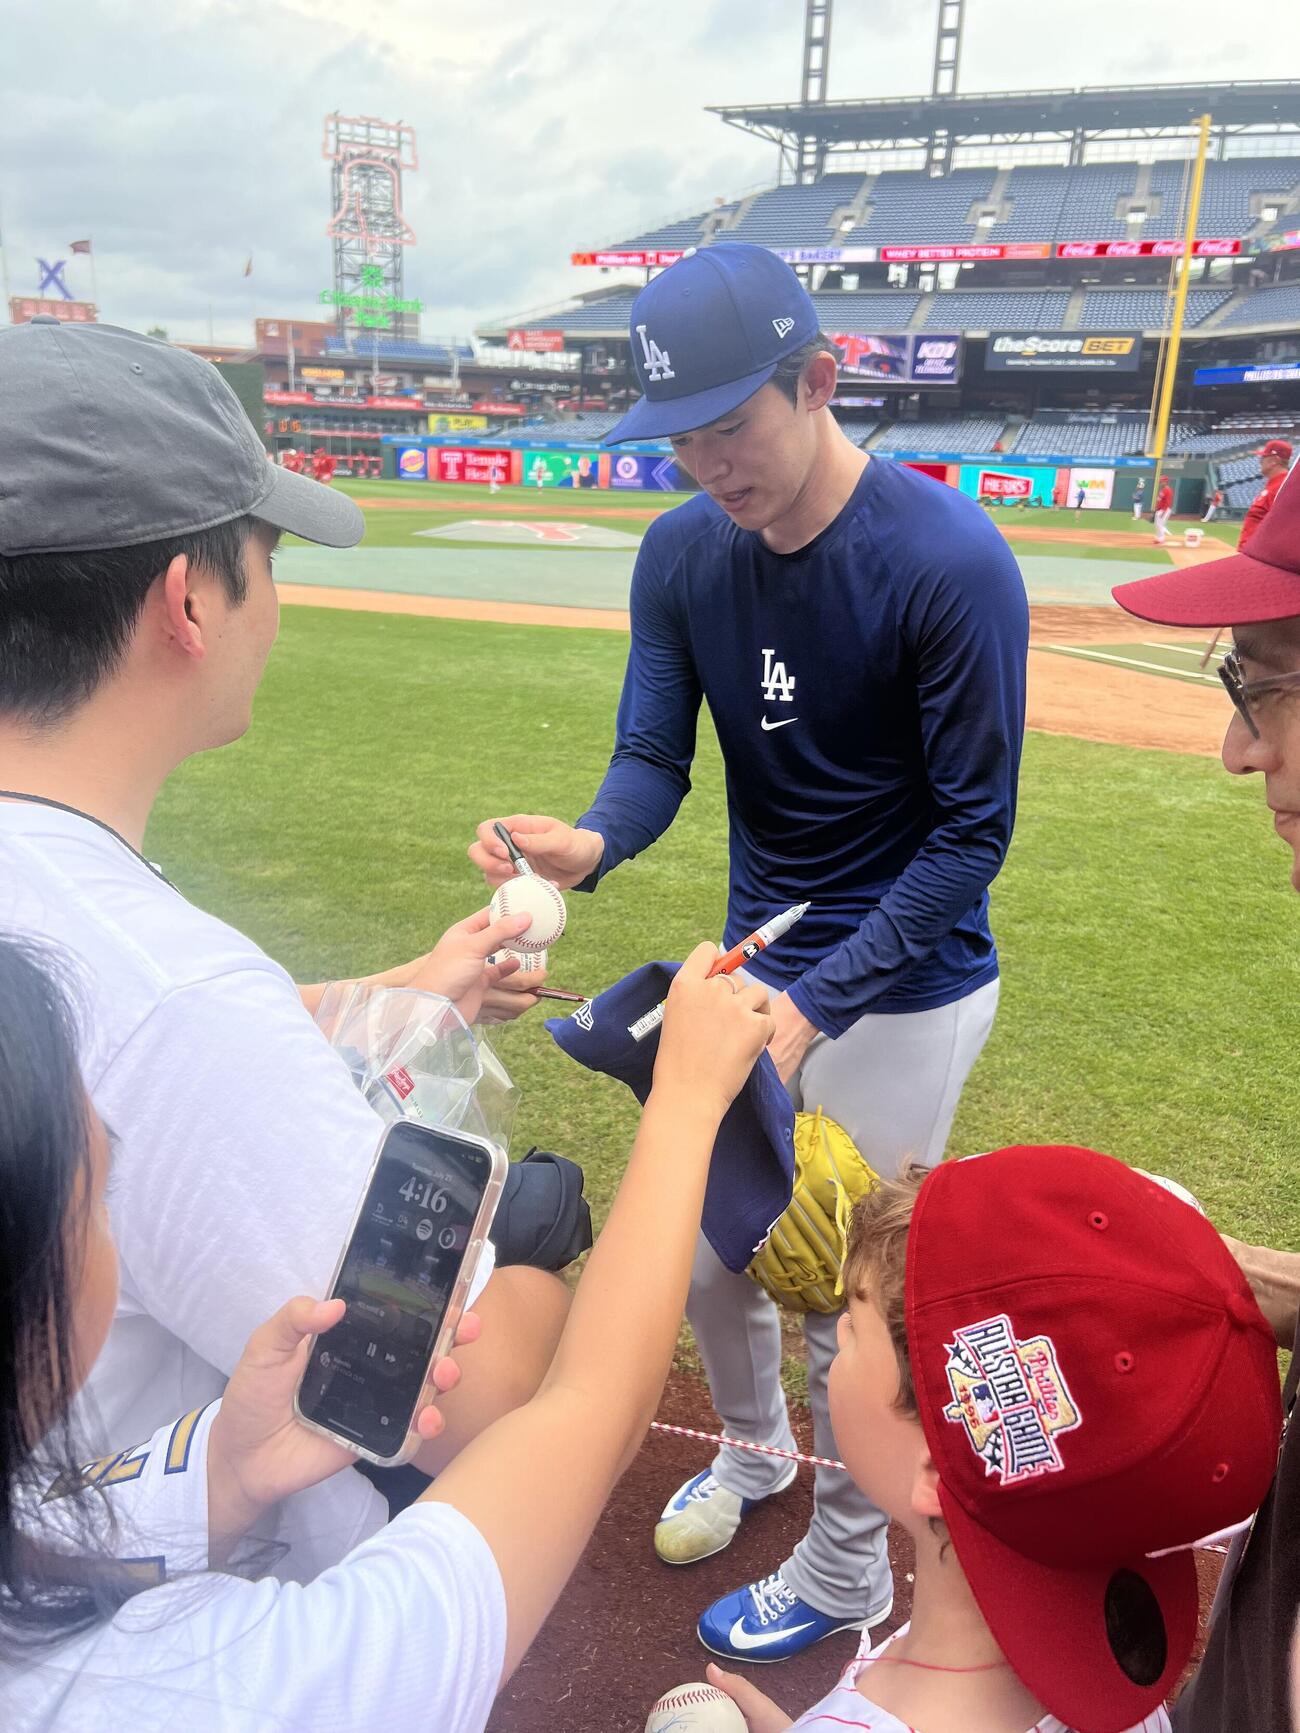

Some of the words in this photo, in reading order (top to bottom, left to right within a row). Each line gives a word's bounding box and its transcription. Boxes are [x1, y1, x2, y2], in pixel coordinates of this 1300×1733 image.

[636, 324, 675, 381] LA
[993, 336, 1083, 352] theScore
[1088, 340, 1130, 352] BET
[464, 452, 510, 467] Temple
[761, 648, 796, 702] LA
[398, 1176, 450, 1214] 4:16
[958, 1384, 980, 1429] 1996
[1029, 1350, 1059, 1420] Phillies
[1004, 1409, 1055, 1474] GAME
